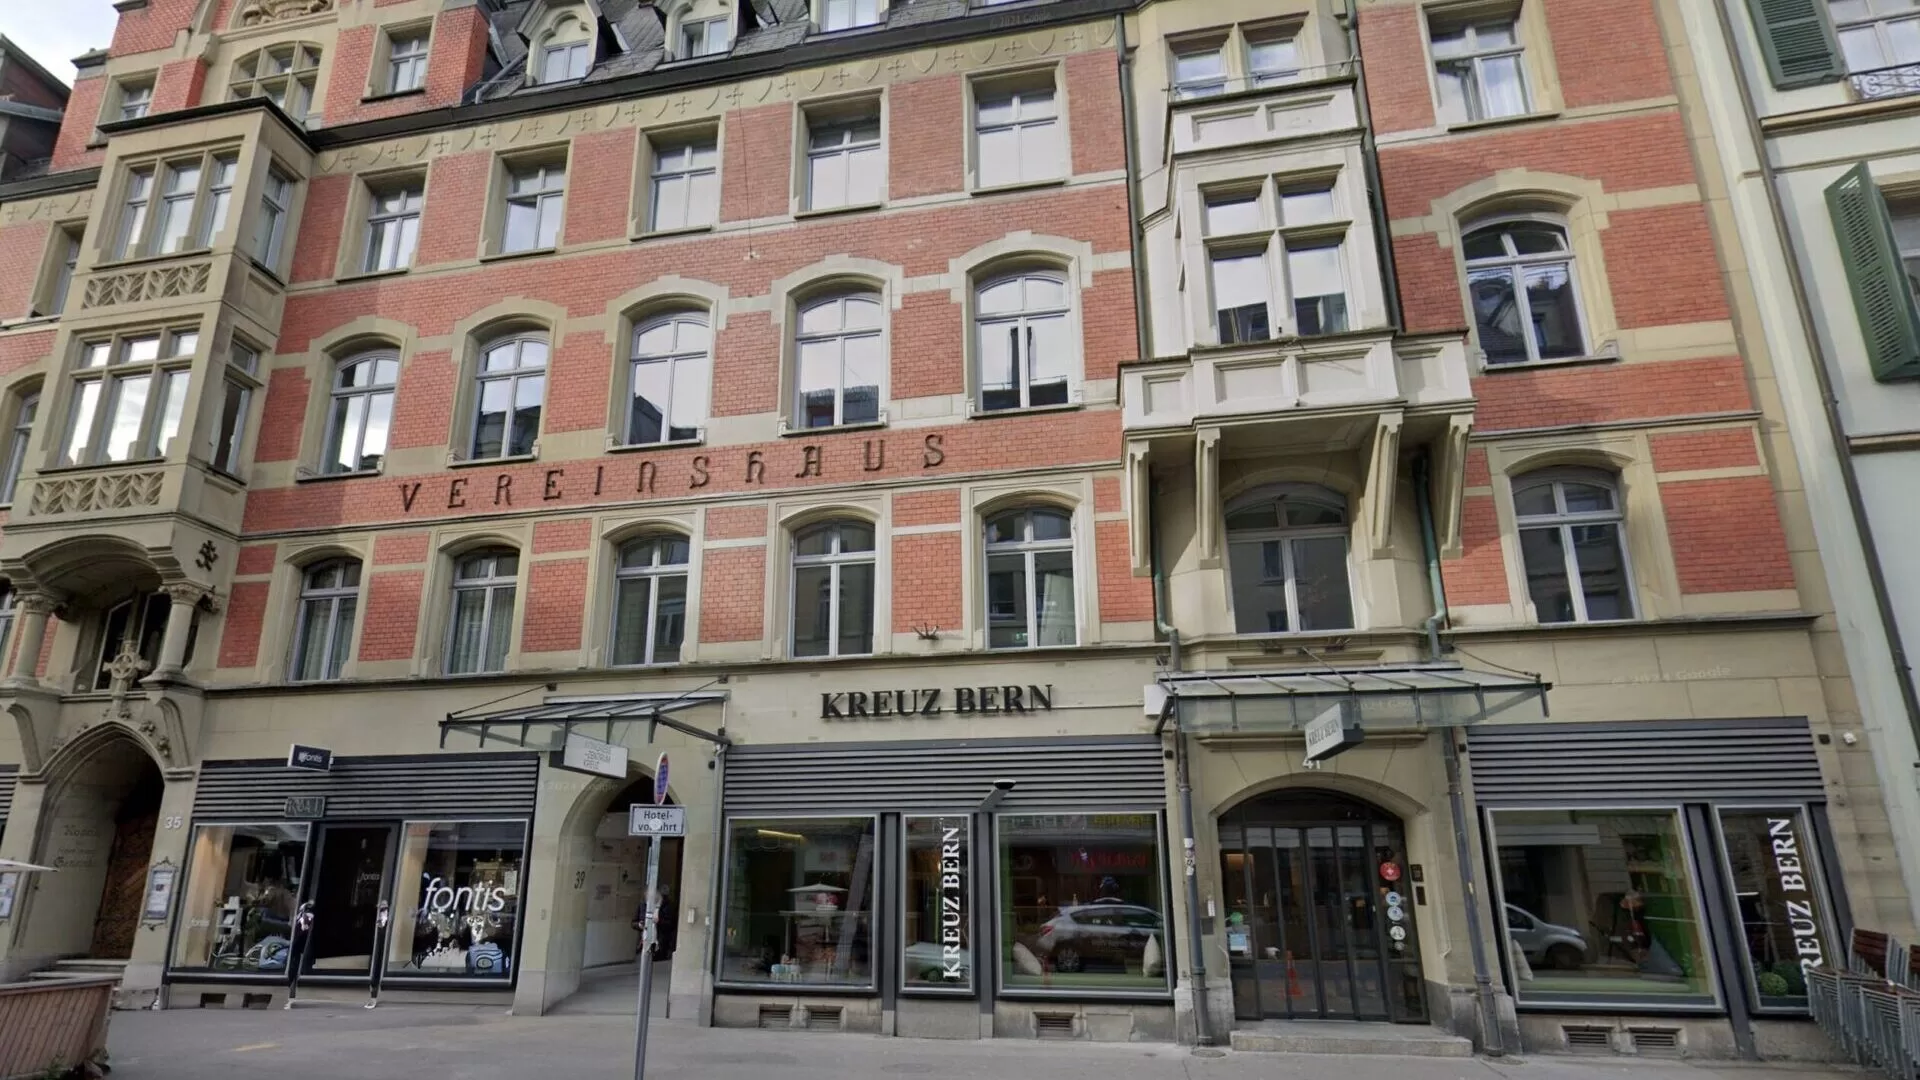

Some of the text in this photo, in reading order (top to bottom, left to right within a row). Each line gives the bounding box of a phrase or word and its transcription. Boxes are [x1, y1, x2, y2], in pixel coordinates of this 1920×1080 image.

[398, 433, 945, 513] VEREINSHAUS
[821, 683, 1053, 721] KREUZ BERN
[164, 816, 182, 829] 35
[638, 822, 677, 832] vohrt
[643, 810, 673, 820] Hotel-
[424, 877, 506, 912] fontis
[574, 870, 586, 889] 39
[943, 827, 960, 979] KREUZ BERN
[1767, 818, 1824, 986] REUZ BERN
